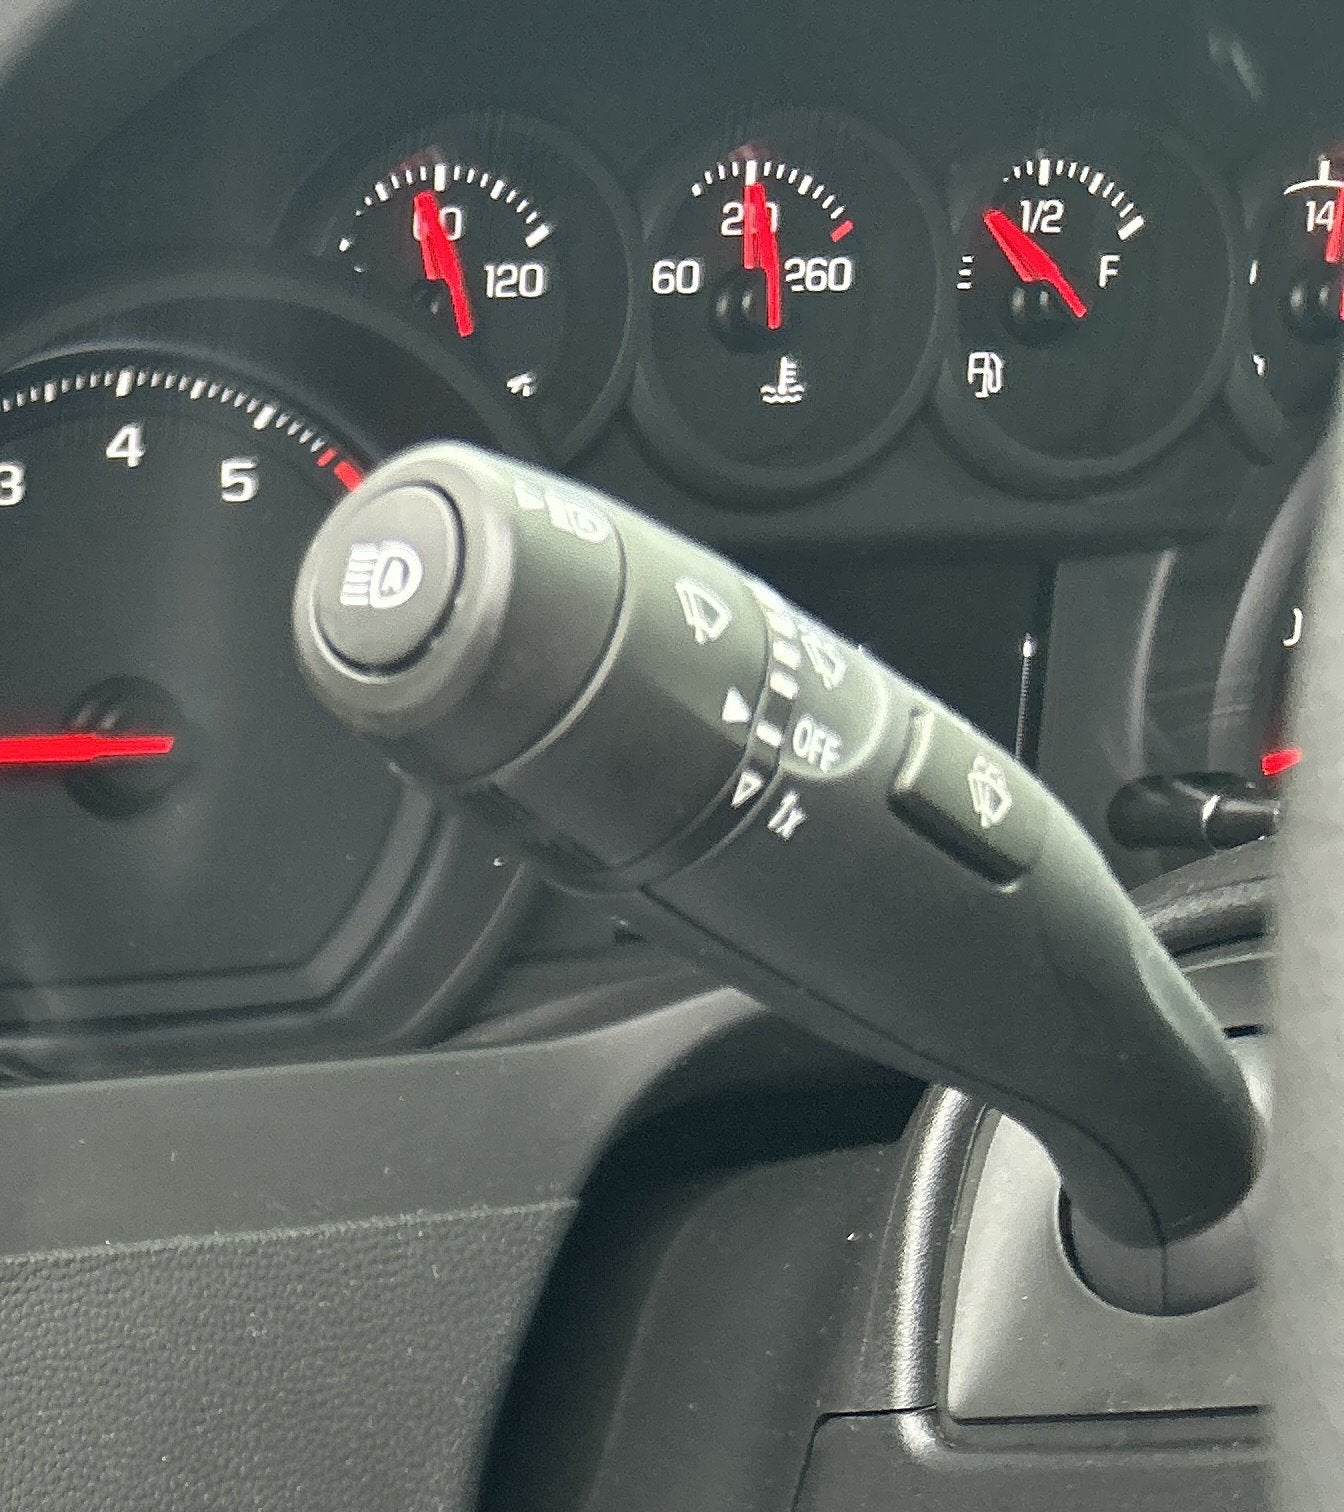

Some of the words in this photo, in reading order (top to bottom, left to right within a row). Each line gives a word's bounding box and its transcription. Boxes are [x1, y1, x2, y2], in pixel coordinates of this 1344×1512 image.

[1019, 199, 1065, 234] 1/2
[484, 261, 547, 298] 120
[652, 258, 701, 294] 60
[784, 256, 853, 292] 260
[1098, 254, 1121, 289] F
[105, 424, 145, 468] 4
[220, 458, 257, 502] 5
[792, 715, 842, 772] OFF
[767, 790, 807, 841] 1x
